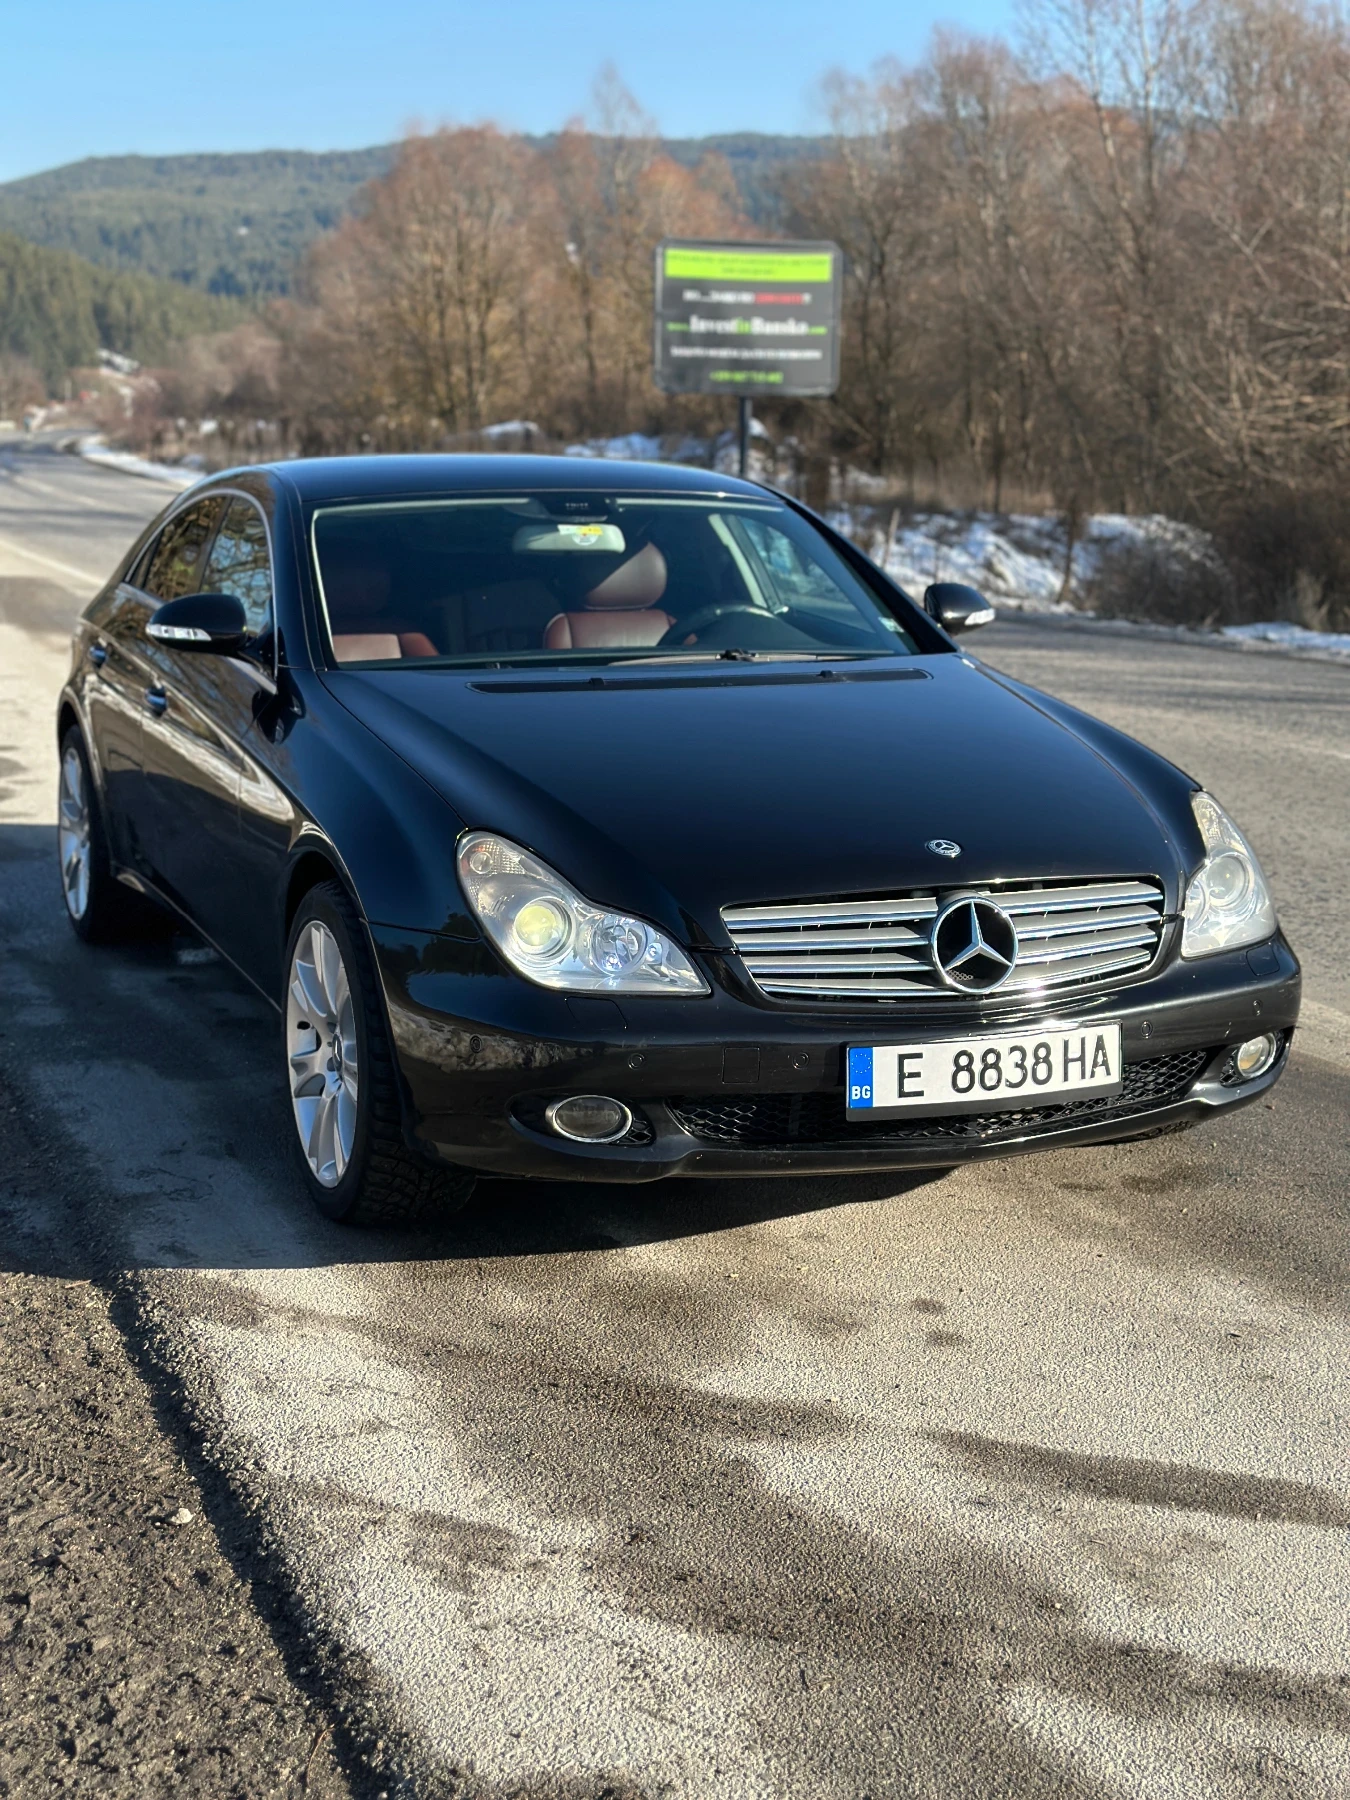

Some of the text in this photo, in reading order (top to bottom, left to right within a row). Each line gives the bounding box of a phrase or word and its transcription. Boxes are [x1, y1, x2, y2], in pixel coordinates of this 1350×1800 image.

[897, 1034, 1112, 1099] E 8838 HA
[851, 1085, 871, 1100] BG
